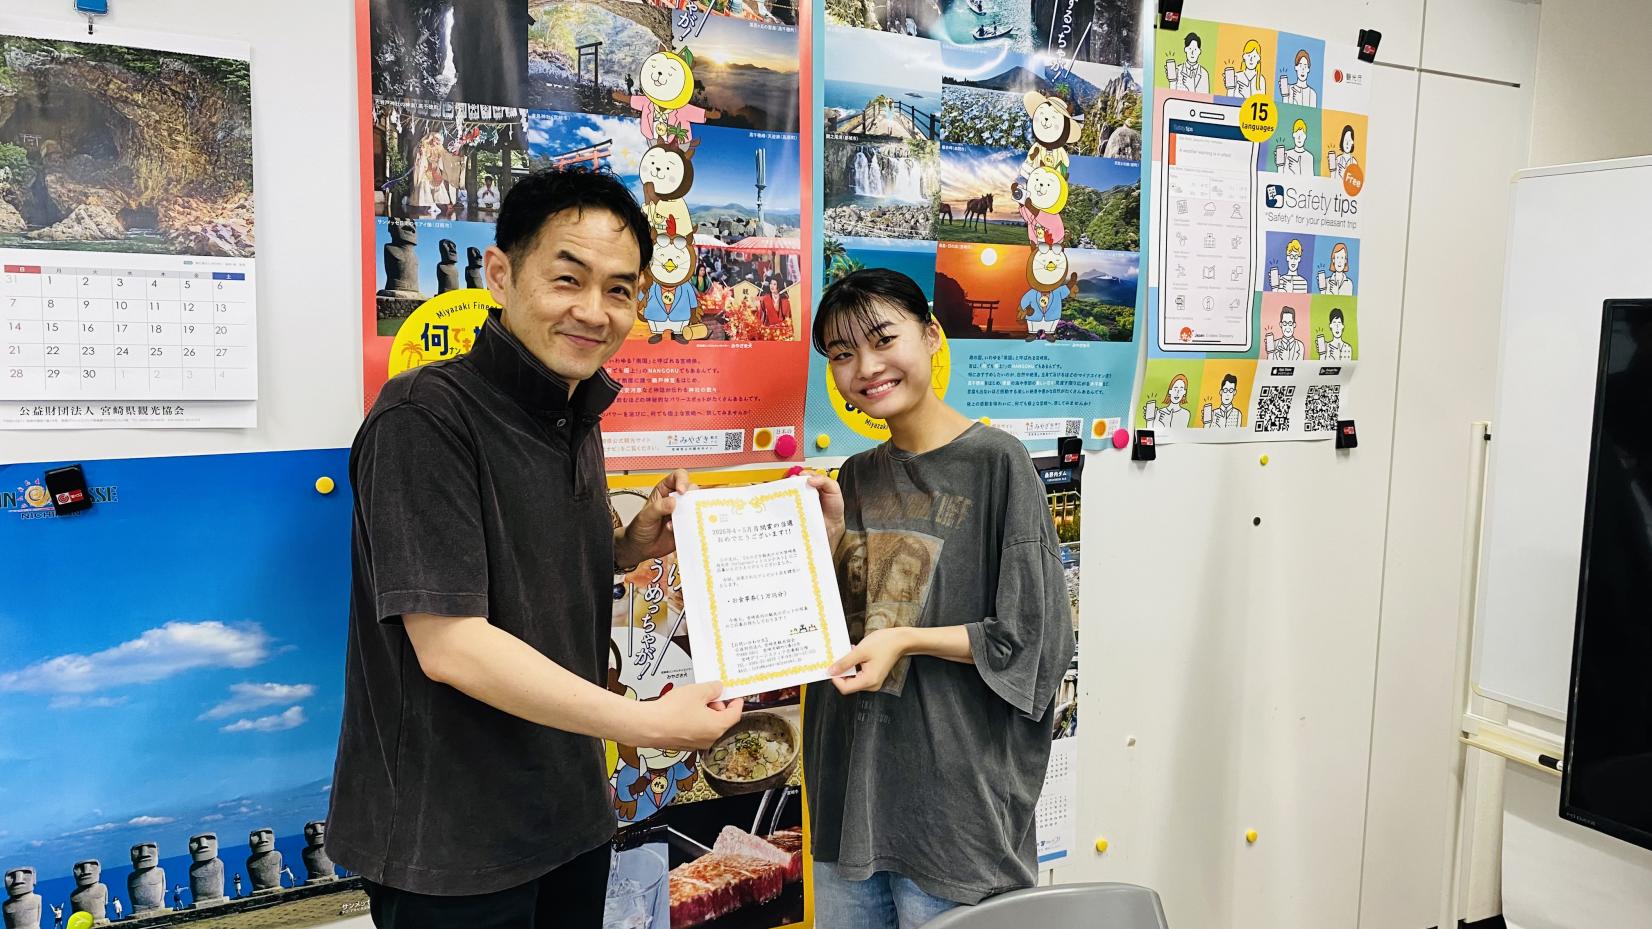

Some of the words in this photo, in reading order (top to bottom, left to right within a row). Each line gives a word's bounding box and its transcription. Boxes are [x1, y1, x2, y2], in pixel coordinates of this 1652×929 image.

[1251, 102, 1269, 122] 15
[1242, 122, 1274, 132] languages
[1345, 172, 1361, 188] Free
[1285, 187, 1332, 216] Safety
[1334, 193, 1358, 217] tips
[1295, 215, 1305, 224] for
[1306, 217, 1320, 227] your
[1320, 218, 1346, 228] pleasant
[1347, 220, 1357, 230] trip
[5, 275, 17, 284] 31
[48, 276, 51, 285] 1
[82, 277, 89, 286] 2
[116, 278, 124, 287] 3
[151, 279, 158, 288] 4
[184, 281, 191, 289] 5
[216, 281, 223, 290] 6
[10, 298, 17, 307] 7
[47, 299, 55, 309] 8
[82, 300, 90, 310] 9
[115, 301, 128, 310] 10
[149, 301, 161, 311] 11
[183, 303, 195, 312] 12
[215, 304, 227, 313] 13
[436, 303, 470, 319] Miyazaki
[8, 322, 22, 331] 14
[46, 322, 59, 332] 15
[82, 323, 94, 332] 16
[116, 324, 128, 333] 17
[150, 324, 162, 334] 18
[183, 325, 195, 334] 19
[215, 326, 227, 335] 20
[8, 345, 20, 355] 21
[46, 346, 60, 356] 22
[81, 346, 95, 356] 23
[116, 347, 129, 356] 24
[150, 347, 163, 357] 25
[183, 348, 195, 357] 26
[216, 348, 227, 357] 27
[10, 369, 23, 378] 28
[47, 369, 60, 379] 29
[82, 369, 96, 379] 30
[121, 369, 126, 379] 1
[153, 370, 160, 379] 2
[186, 370, 193, 379] 3
[219, 371, 225, 379] 4
[19, 405, 94, 417] 公益財団法人
[100, 404, 185, 416] 宮崎県観光協会
